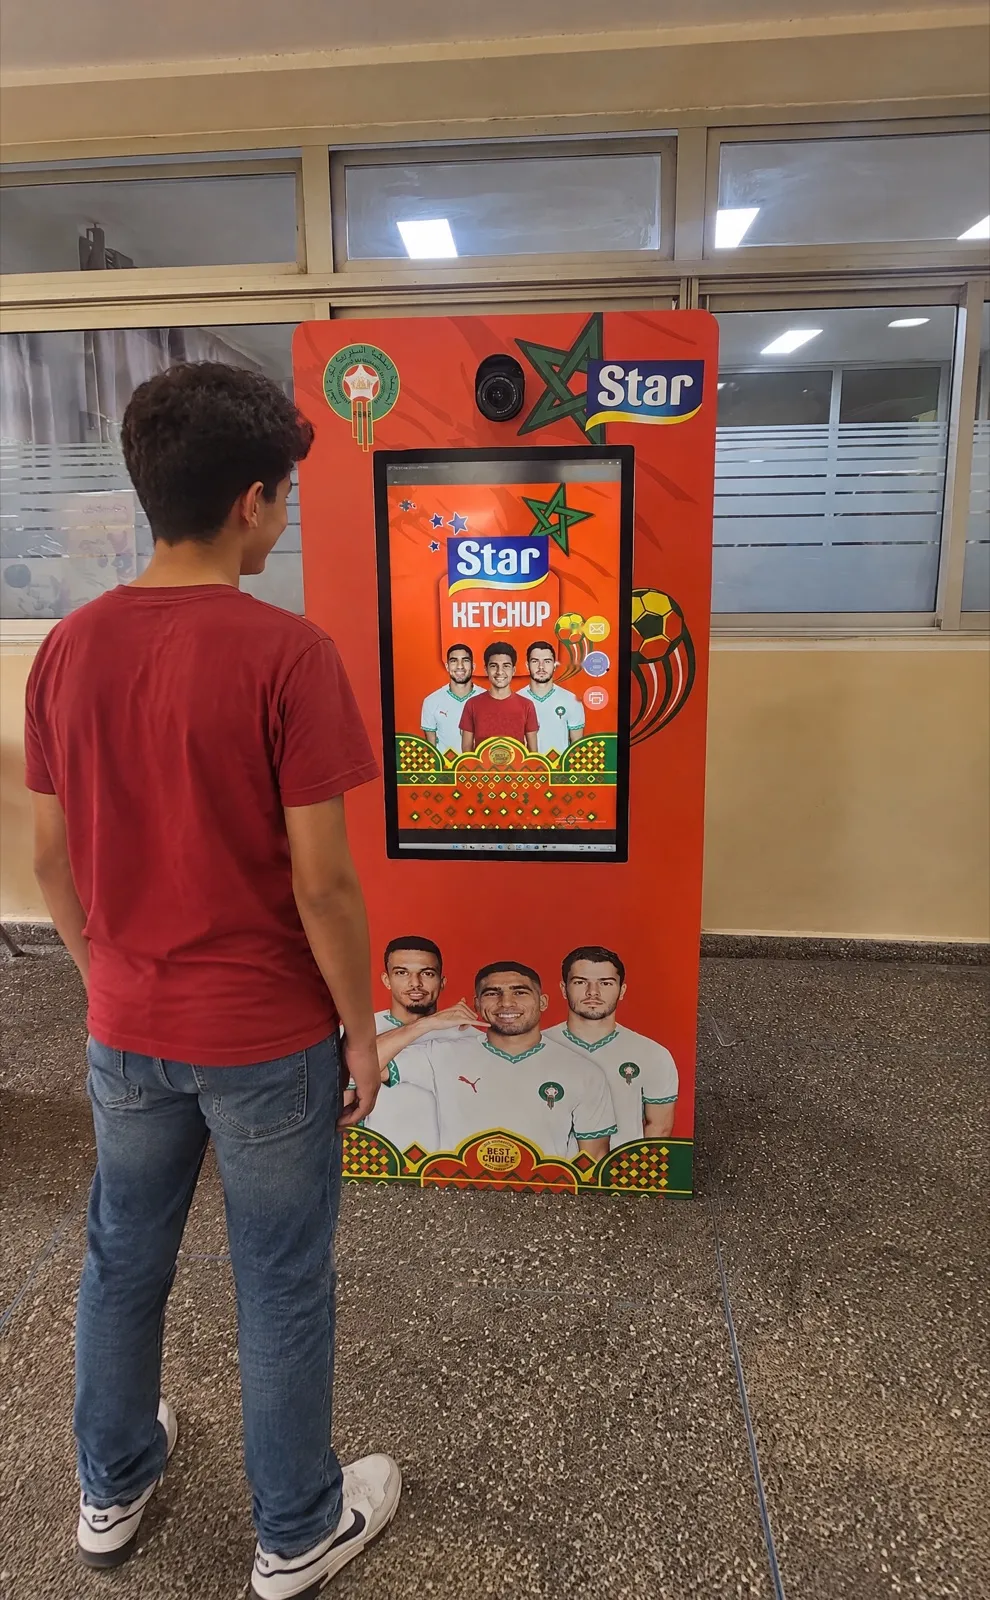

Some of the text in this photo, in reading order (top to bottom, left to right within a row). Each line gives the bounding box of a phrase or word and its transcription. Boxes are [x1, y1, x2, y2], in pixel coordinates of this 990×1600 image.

[597, 364, 694, 407] Star
[456, 540, 541, 576] Star
[452, 601, 551, 628] KETCHUP
[482, 1155, 515, 1163] CHOICE
